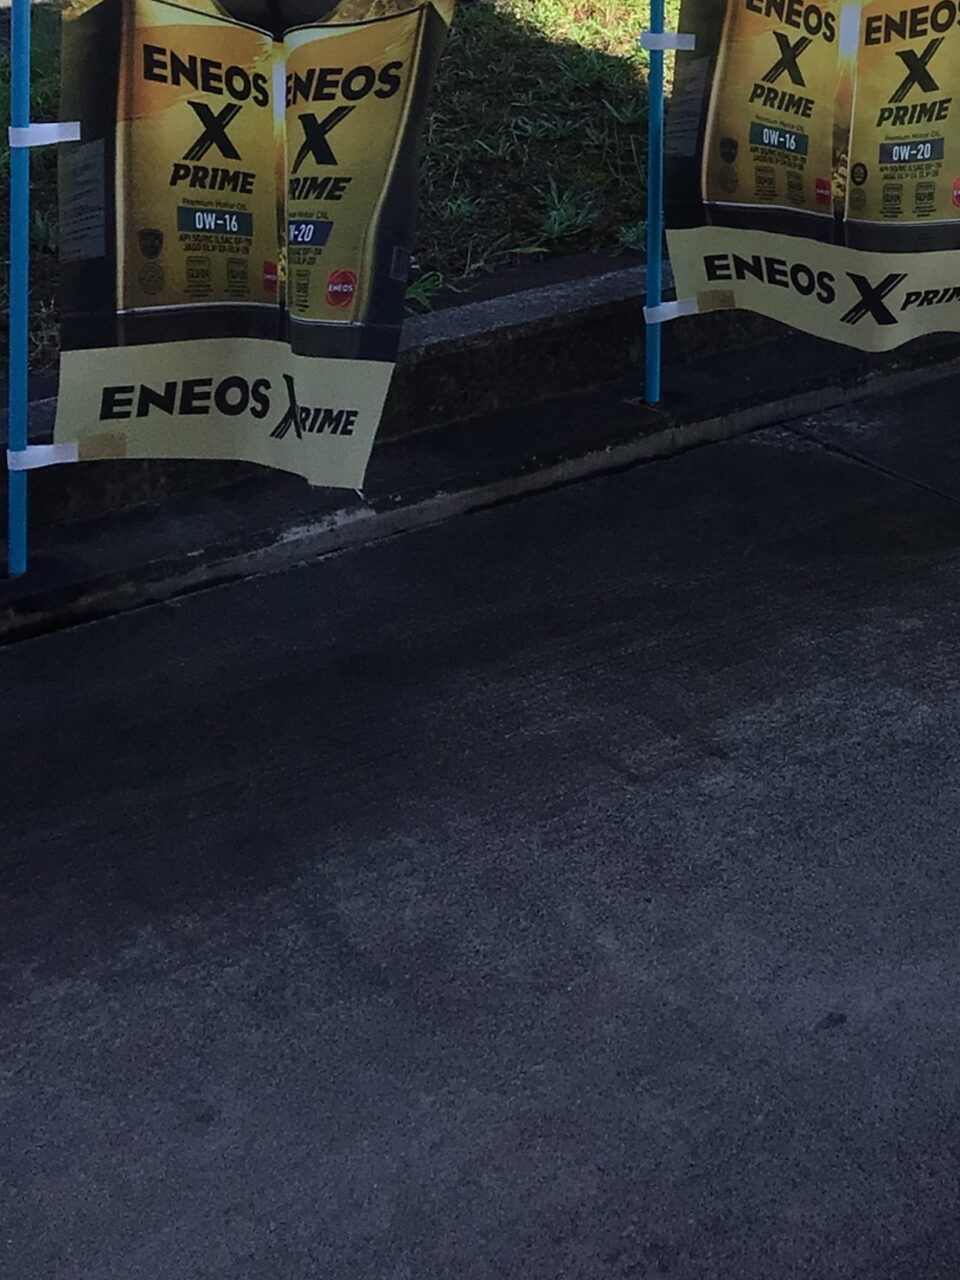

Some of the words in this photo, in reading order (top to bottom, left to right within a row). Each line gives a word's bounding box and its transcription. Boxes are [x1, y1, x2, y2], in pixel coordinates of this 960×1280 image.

[143, 44, 269, 107] ENEOS
[761, 31, 813, 88] X
[888, 36, 945, 104] X
[749, 83, 815, 119] PRIME
[876, 97, 953, 128] PRIME
[182, 100, 243, 160] X
[292, 105, 356, 174] X
[763, 128, 796, 150] 0W-16
[892, 143, 931, 161] 0W-20
[169, 163, 255, 194] PRIME
[289, 177, 352, 201] RIME
[195, 211, 239, 232] 0W-16
[328, 283, 354, 292] ENEOS
[703, 253, 836, 305] ENEOS
[839, 271, 908, 326] X
[101, 375, 271, 421] ENEOS
